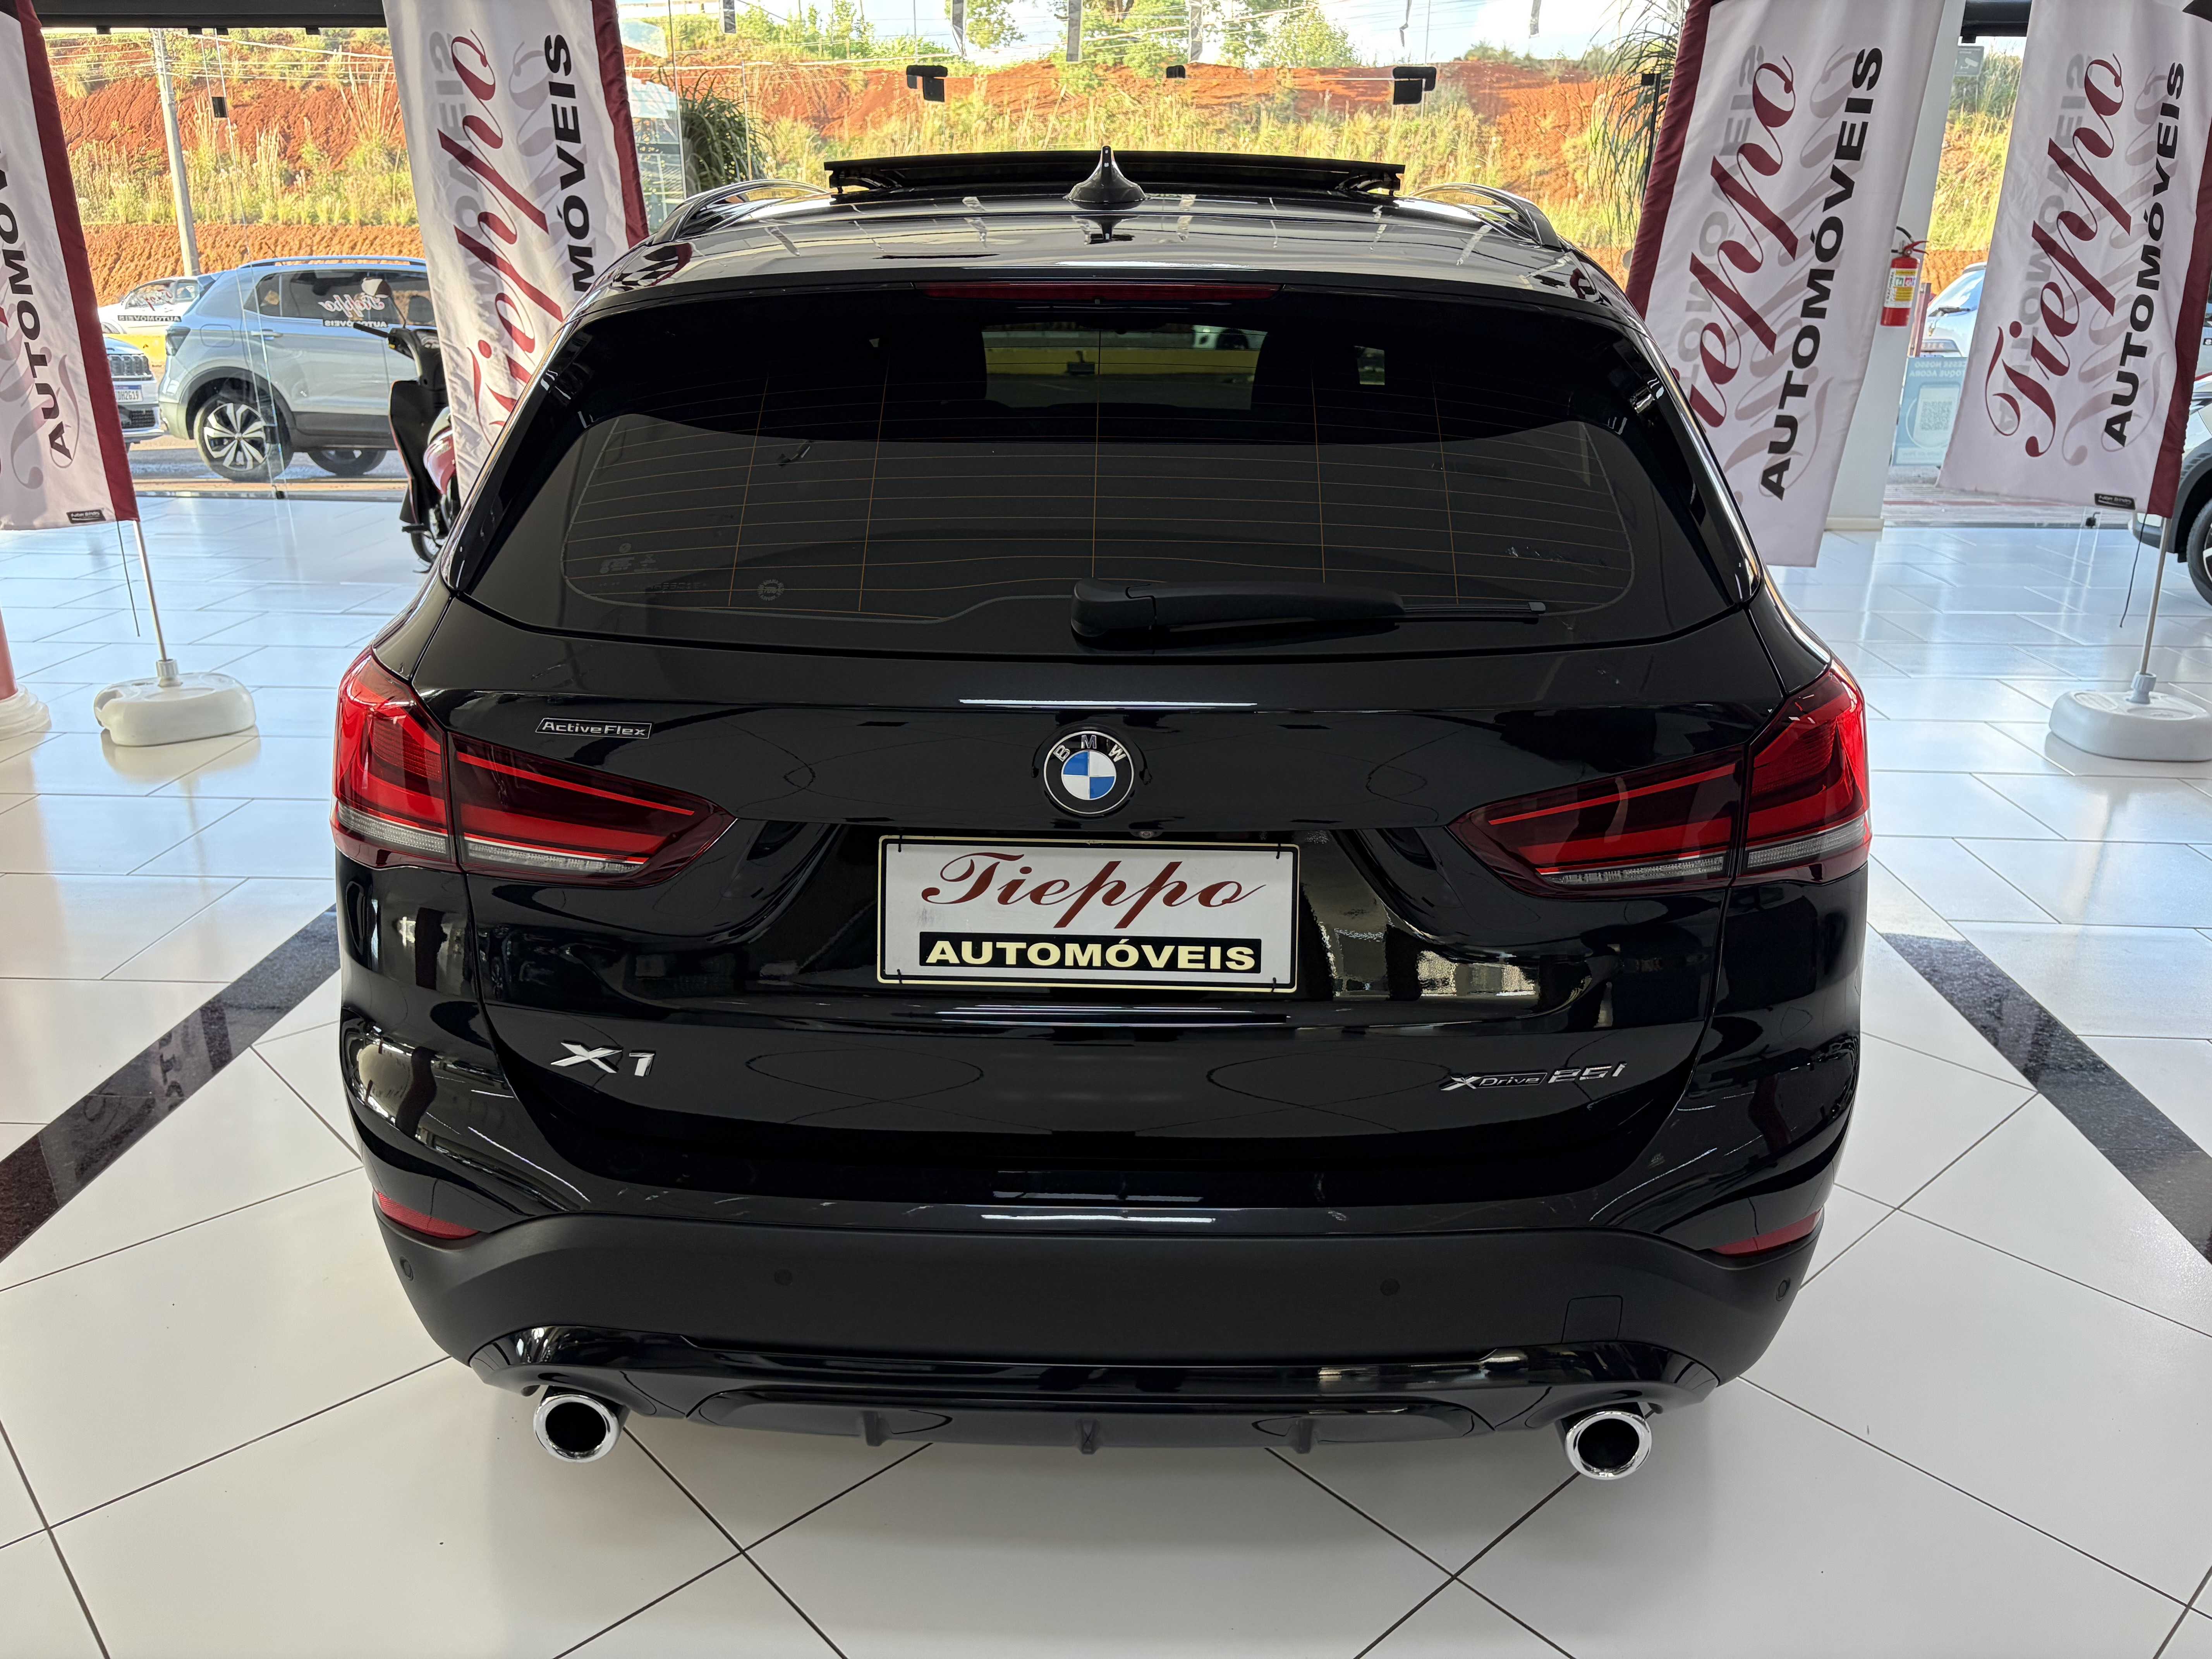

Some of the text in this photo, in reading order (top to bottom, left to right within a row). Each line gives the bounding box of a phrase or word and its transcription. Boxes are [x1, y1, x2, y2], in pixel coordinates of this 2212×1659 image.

[544, 34, 597, 293] MÓVEIS
[1672, 55, 1799, 432] ieppo
[1760, 47, 1883, 501] AUTOMÓVEIS
[1985, 53, 2131, 458] Tieppo
[2104, 62, 2185, 447] AUTOMÓVEIS
[542, 721, 646, 736] ActiveFlex
[1053, 735, 1127, 762] BMW
[921, 852, 1266, 929] Tieppo
[926, 939, 1255, 971] AUTOMÓVEIS
[550, 1042, 655, 1077] X1
